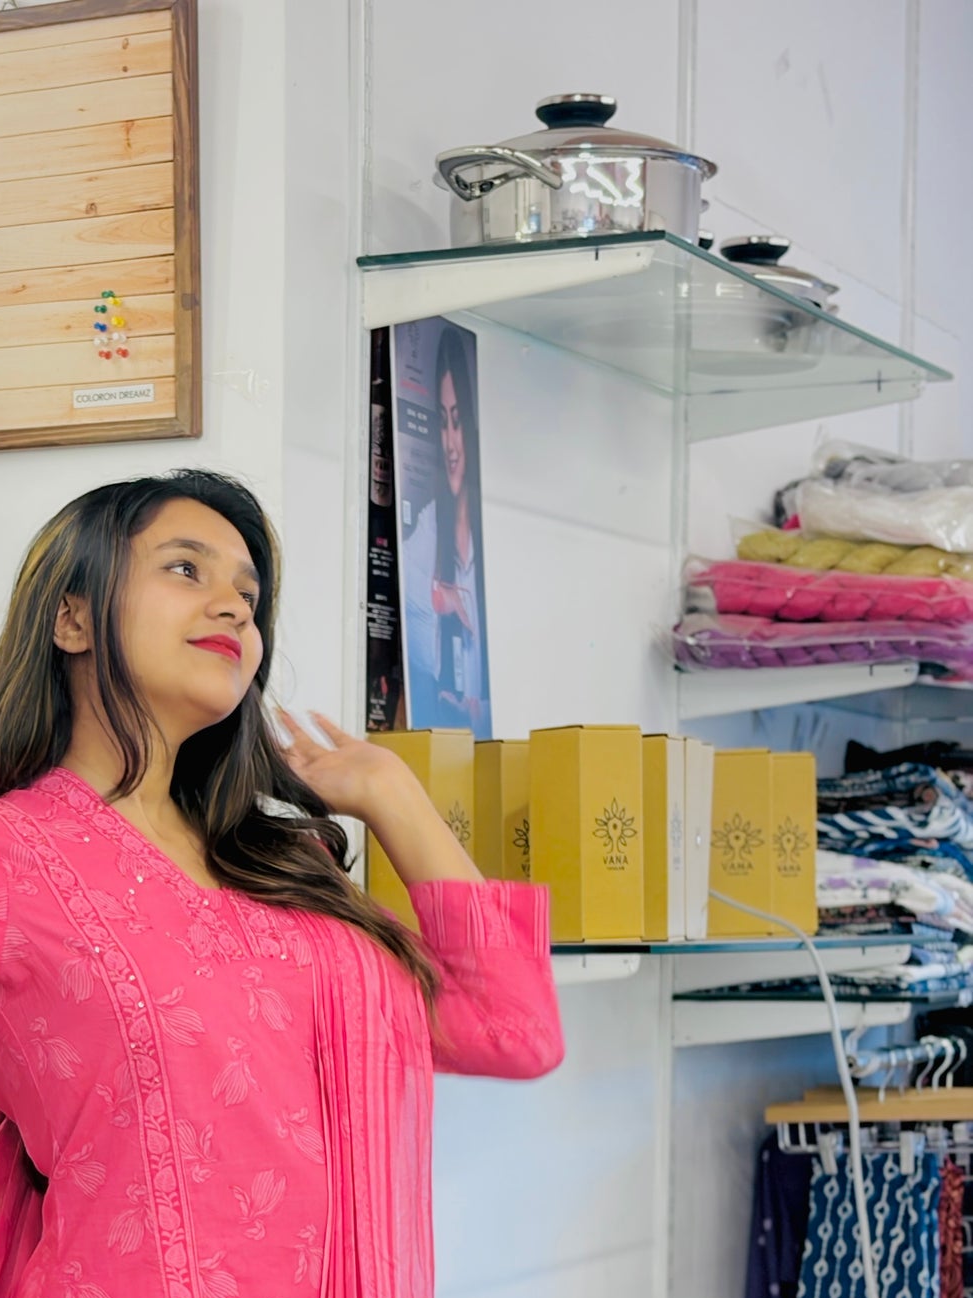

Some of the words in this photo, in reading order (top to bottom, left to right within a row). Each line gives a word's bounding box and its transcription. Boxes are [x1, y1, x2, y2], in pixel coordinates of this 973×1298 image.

[76, 392, 117, 404] COLORON
[119, 389, 151, 400] DREAMZ
[603, 855, 628, 865] VANA
